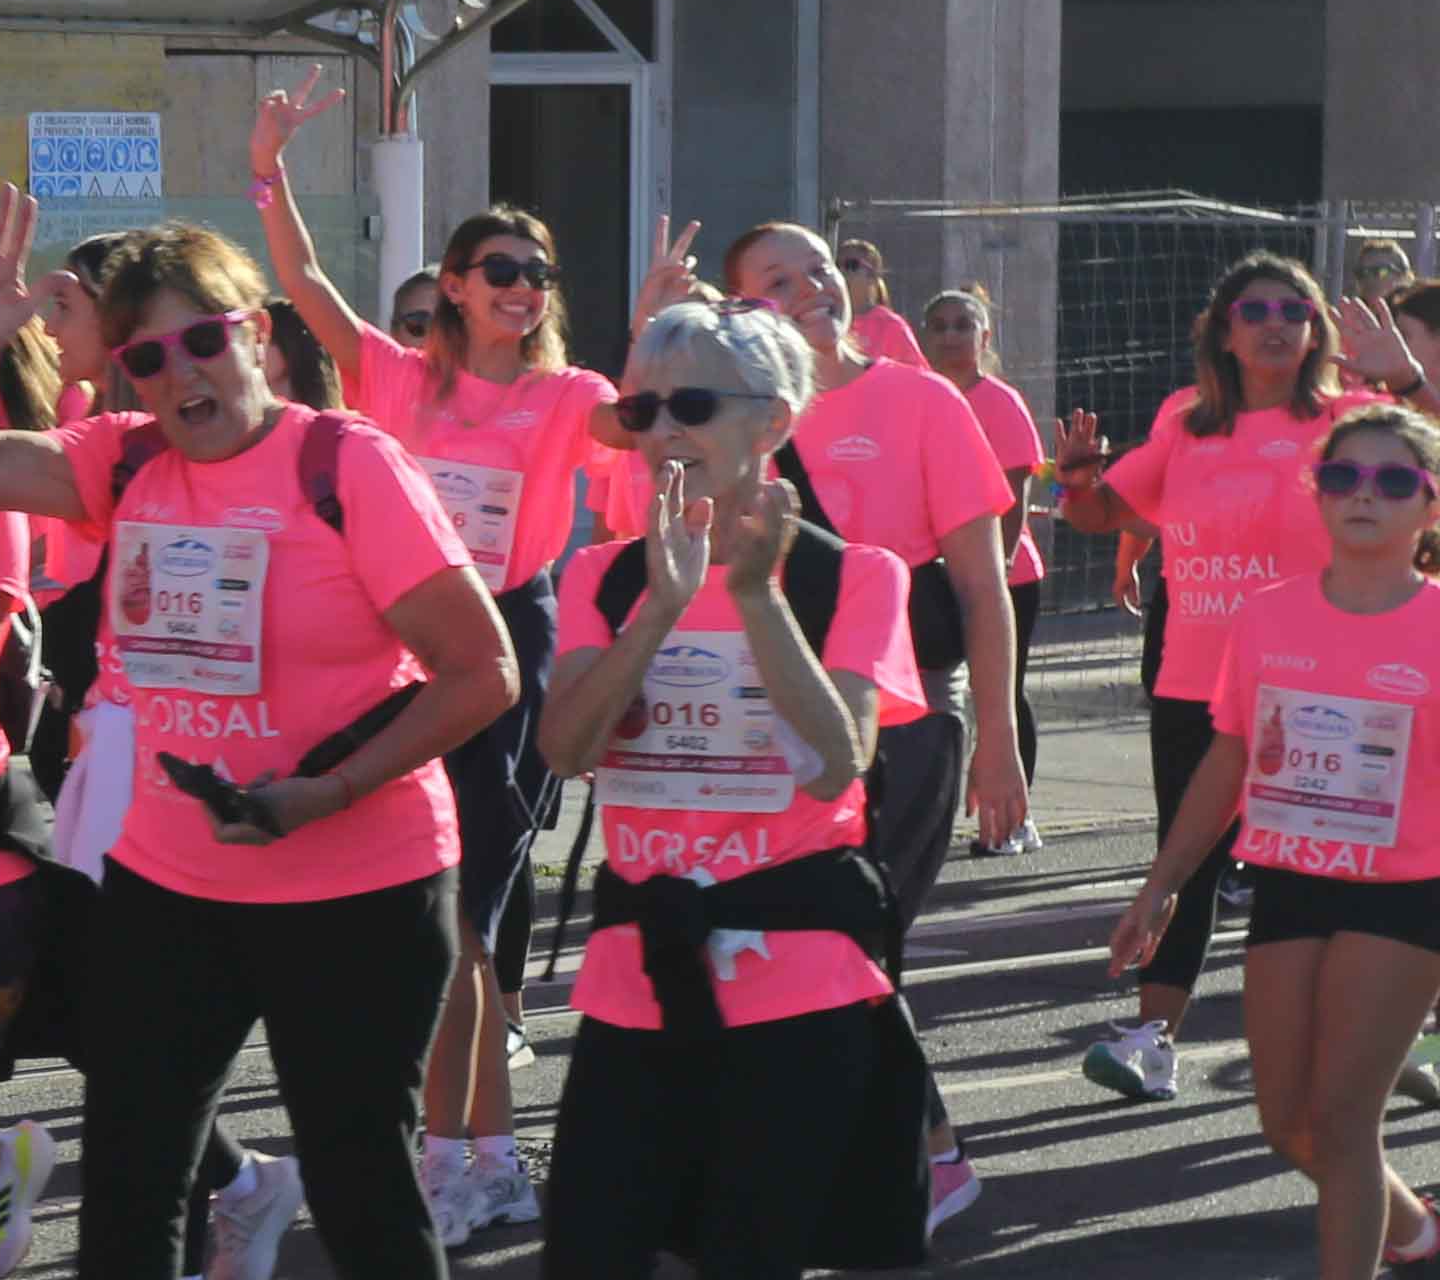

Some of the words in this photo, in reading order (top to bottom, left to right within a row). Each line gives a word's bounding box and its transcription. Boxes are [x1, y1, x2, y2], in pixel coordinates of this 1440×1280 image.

[1175, 555, 1280, 582] DORSAL
[157, 589, 203, 614] 016
[138, 694, 280, 738] ORSAL
[653, 702, 721, 728] 016
[1288, 748, 1342, 772] 016
